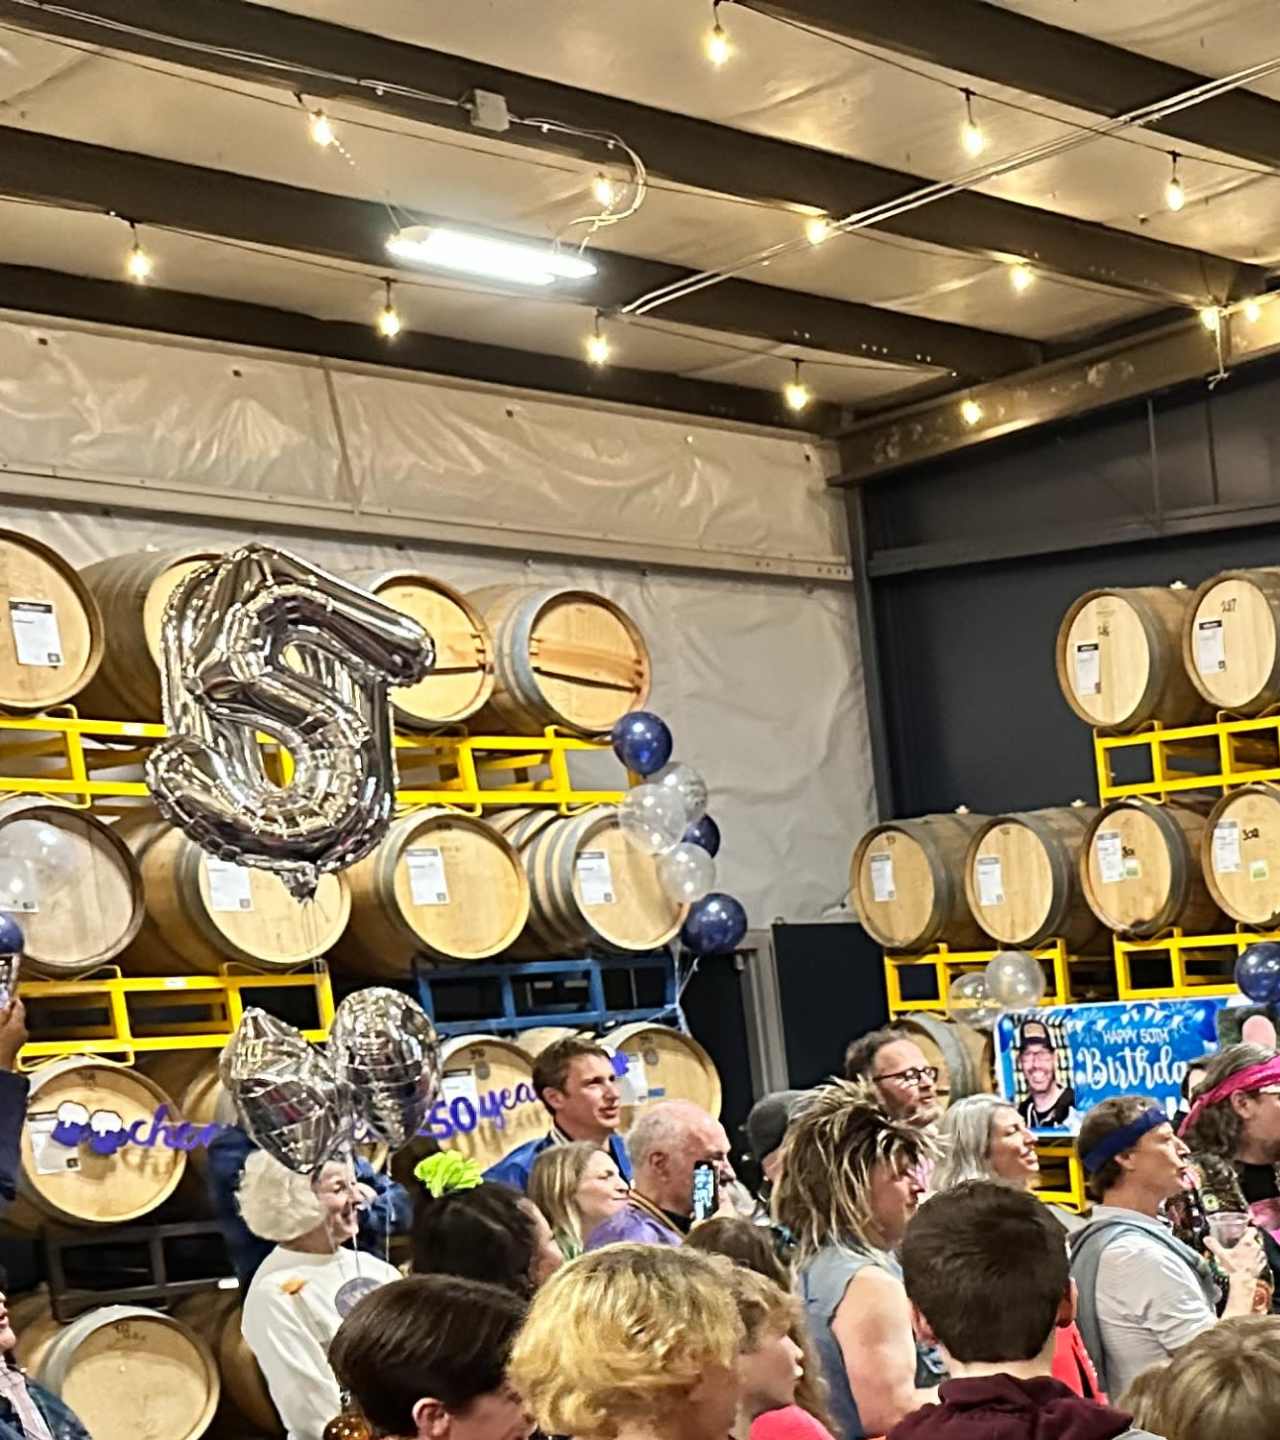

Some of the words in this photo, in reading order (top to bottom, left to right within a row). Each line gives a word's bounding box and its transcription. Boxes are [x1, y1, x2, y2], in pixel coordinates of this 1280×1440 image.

[1102, 1025, 1136, 1044] HAPPY
[1140, 1024, 1169, 1043] 50TH
[1079, 1046, 1187, 1091] Birthda
[479, 1082, 537, 1130] yea
